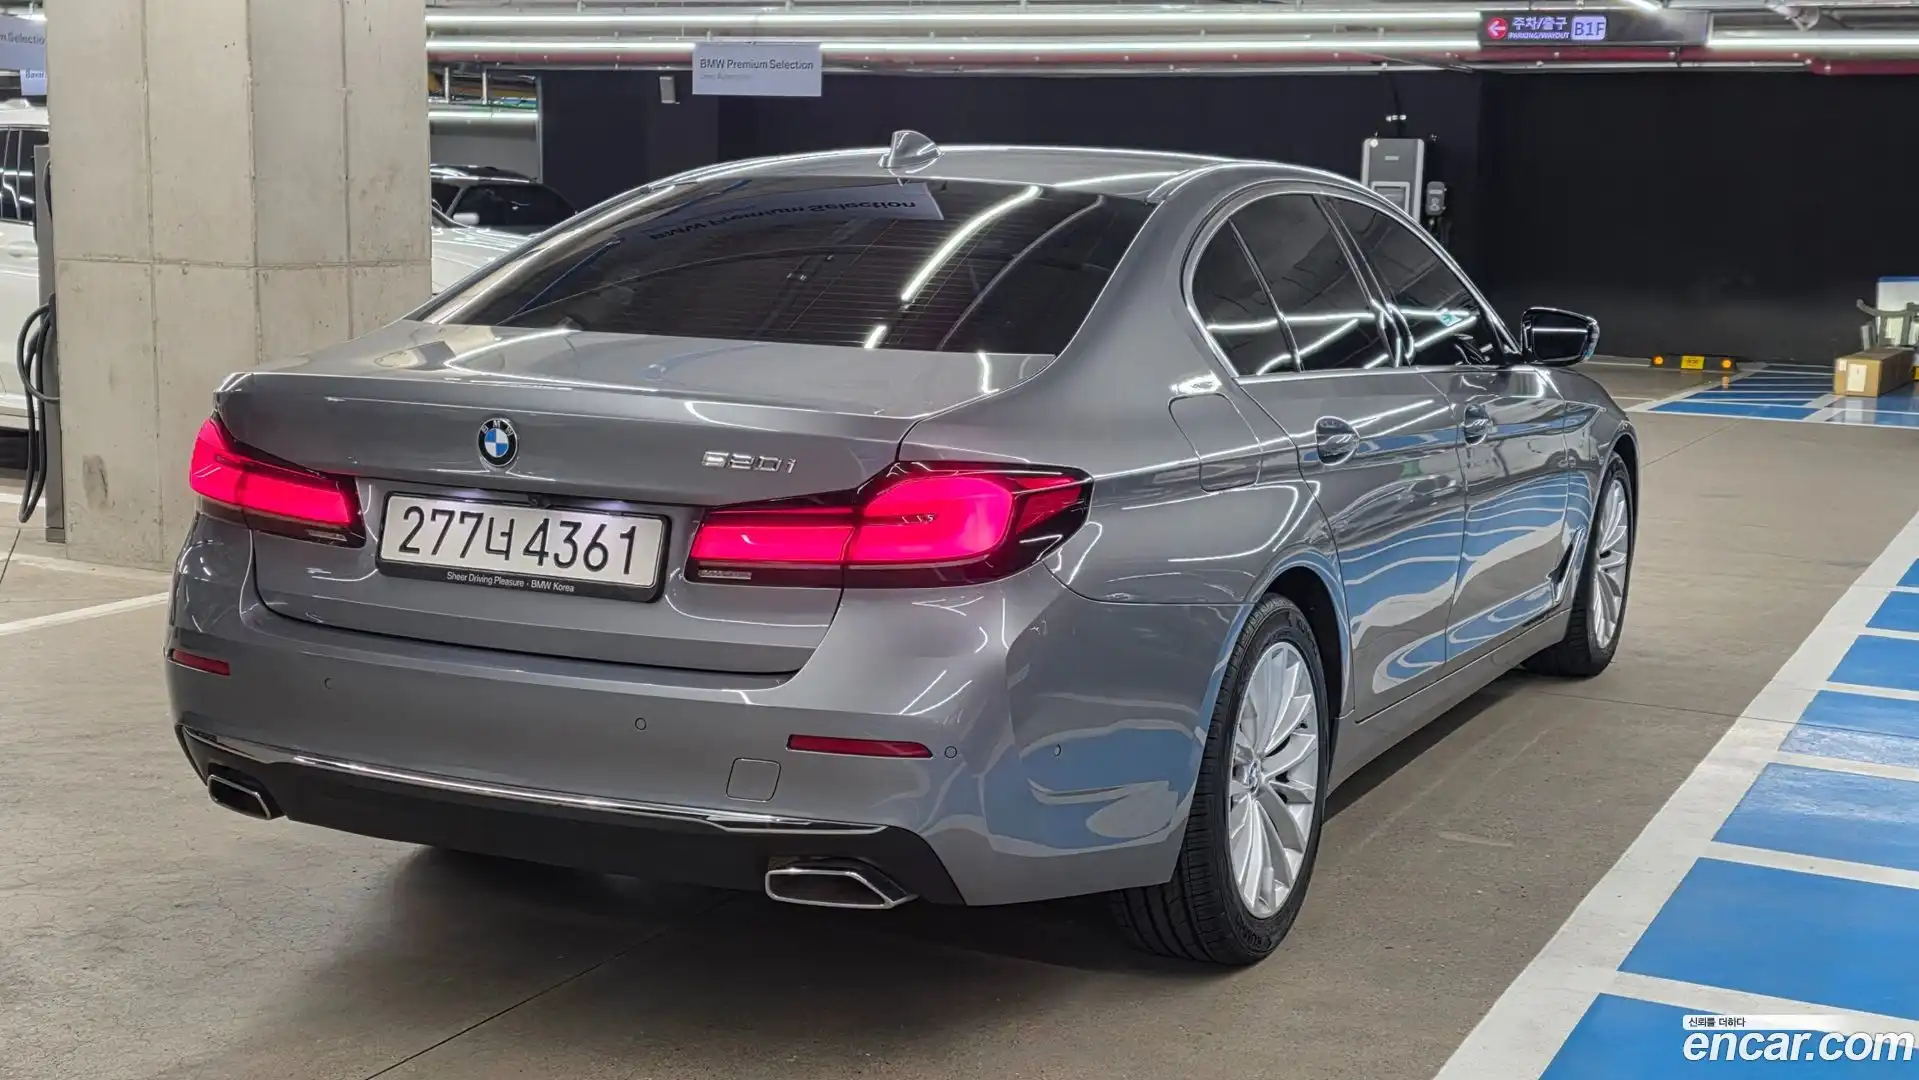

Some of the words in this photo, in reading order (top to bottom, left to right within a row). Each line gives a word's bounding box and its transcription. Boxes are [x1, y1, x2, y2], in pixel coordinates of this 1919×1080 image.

[8, 32, 45, 45] Selectio
[1574, 21, 1605, 37] B1F
[699, 58, 725, 69] BMW
[726, 59, 768, 70] Premium
[769, 60, 814, 71] Selection
[702, 451, 797, 474] 520i
[398, 505, 515, 561] 277너
[522, 517, 638, 576] 4361
[446, 571, 468, 582] Sheer
[468, 573, 493, 586] Driving
[493, 575, 525, 588] Pleasure
[531, 579, 552, 590] BMW
[552, 582, 575, 593] Korea
